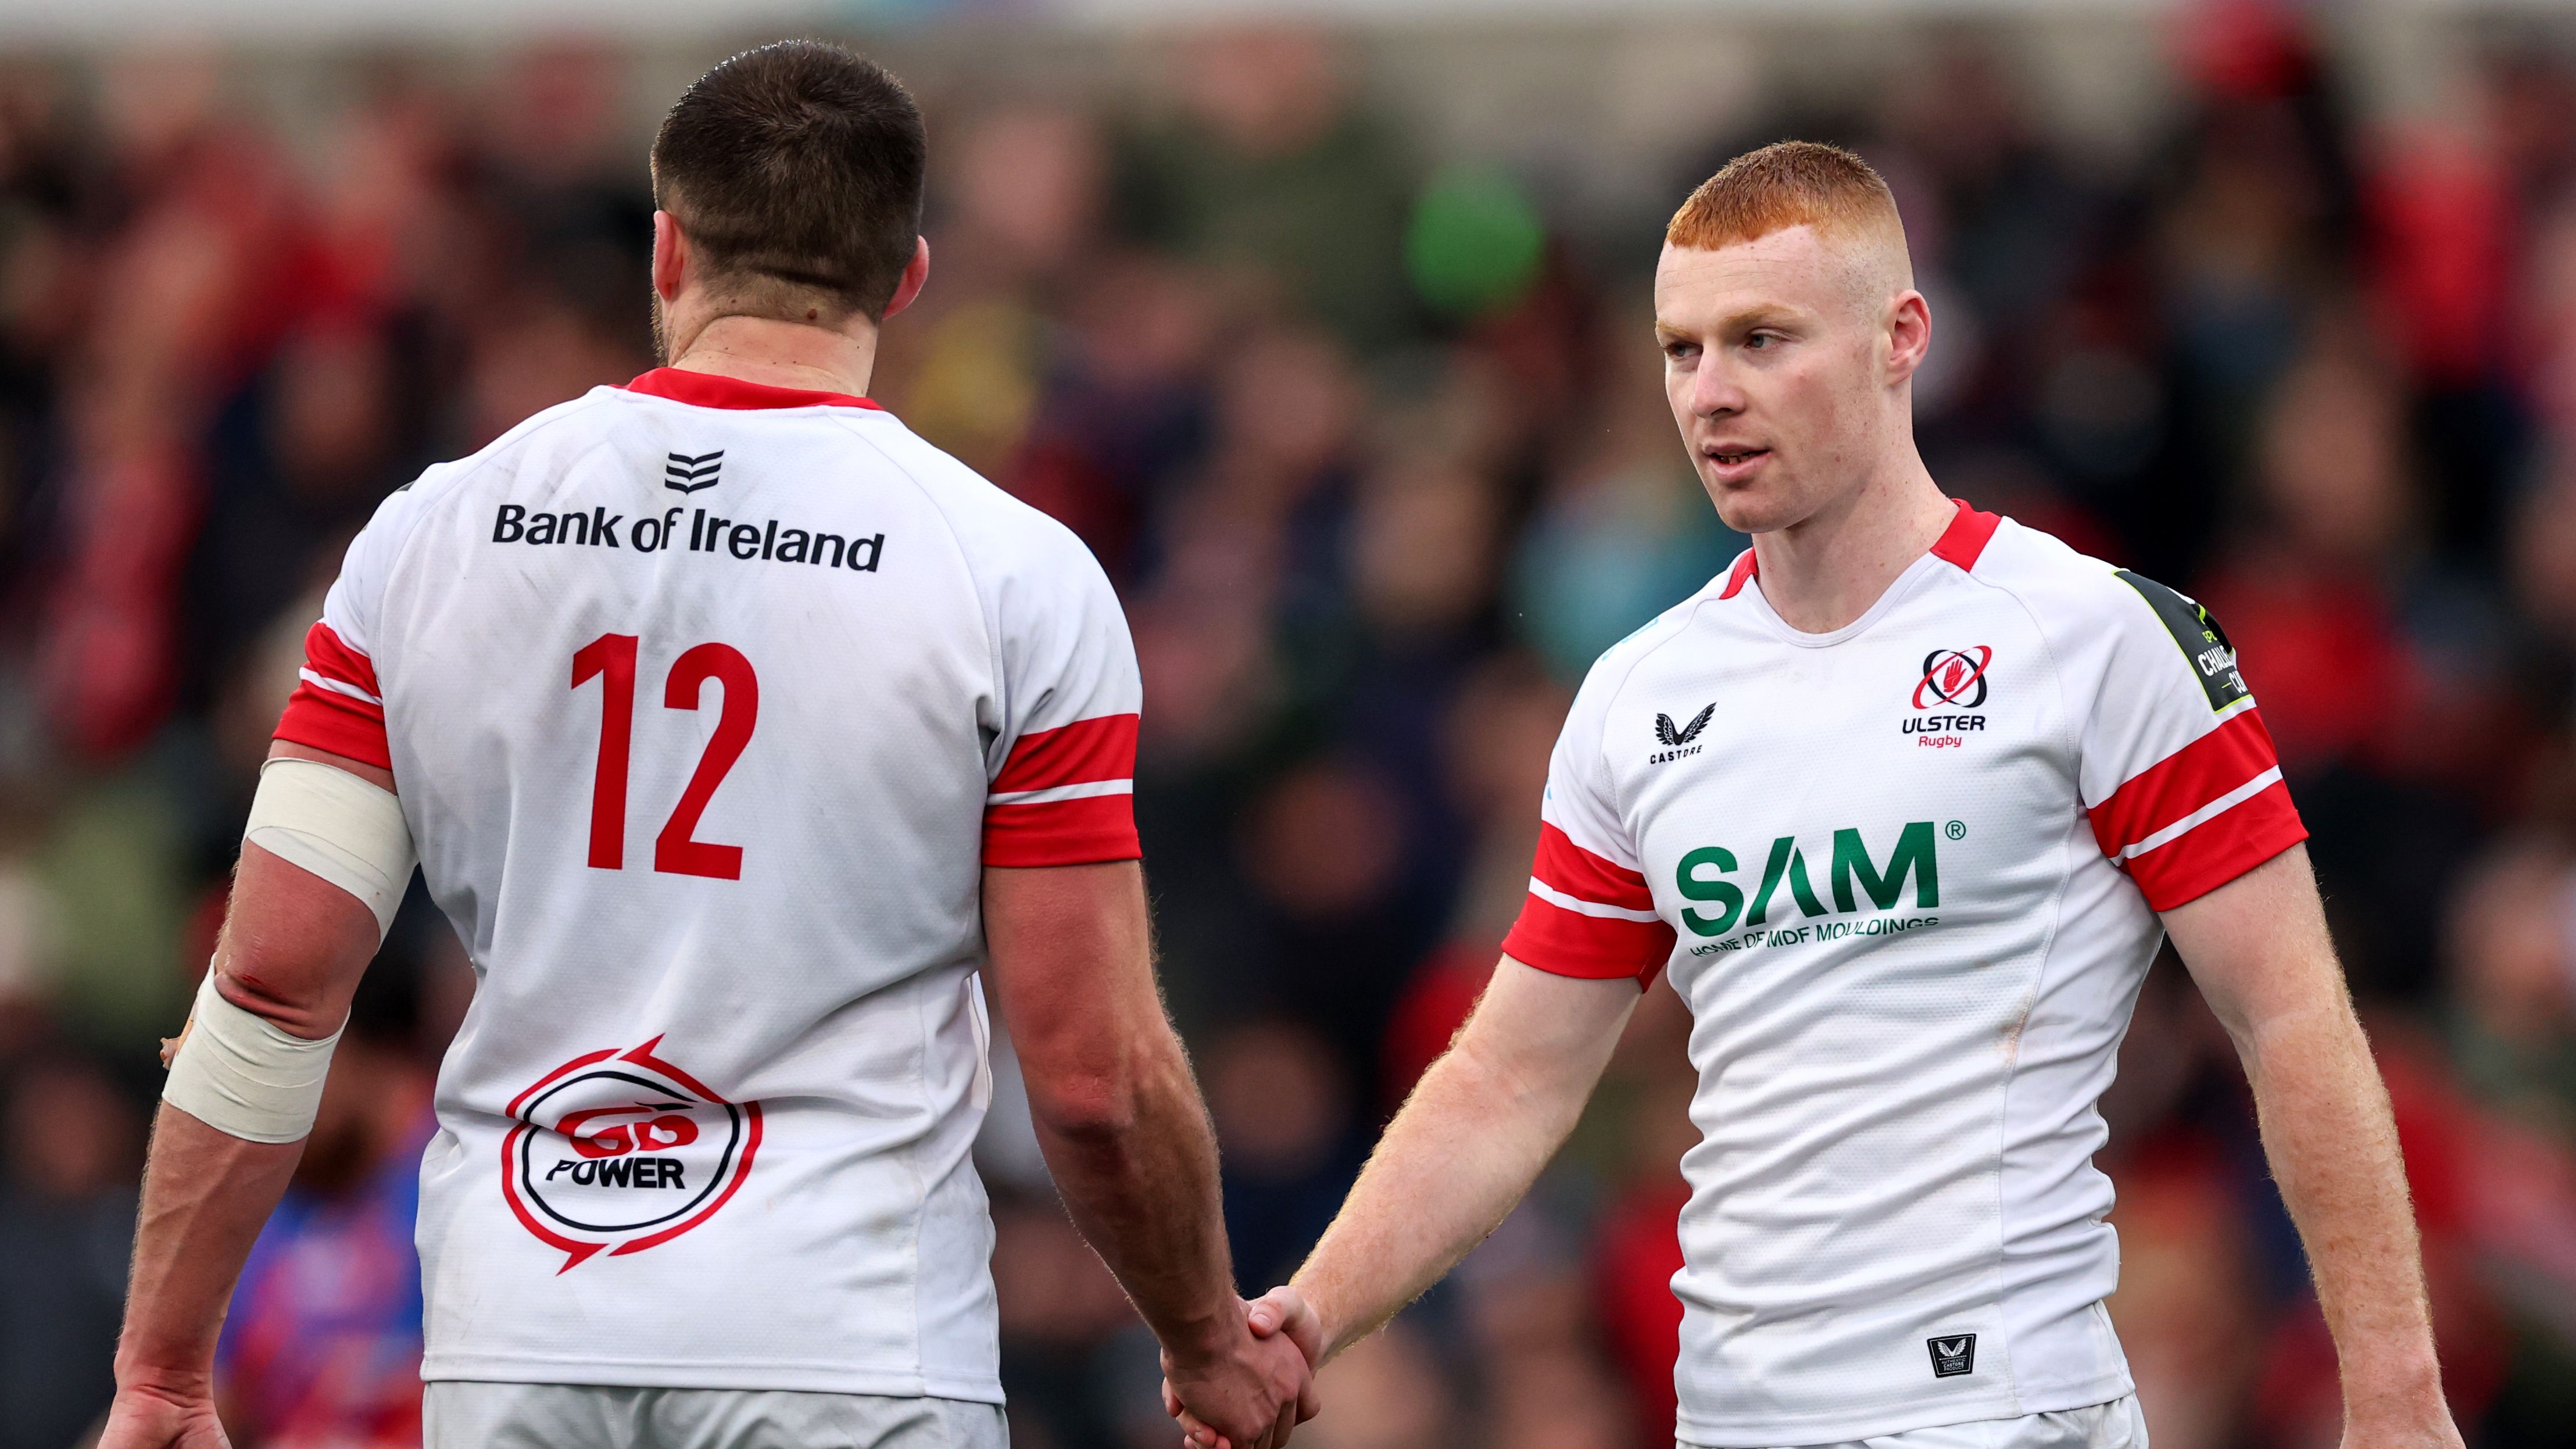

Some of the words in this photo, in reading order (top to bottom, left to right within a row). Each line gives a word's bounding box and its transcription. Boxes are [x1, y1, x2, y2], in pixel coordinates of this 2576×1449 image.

[492, 505, 624, 548] Bank
[631, 507, 683, 553] of
[690, 509, 885, 573] Ireland
[1902, 715, 1985, 734] ULSTER
[1919, 735, 1962, 748] Rugby
[571, 632, 759, 881] 12
[1650, 745, 1702, 764] CASTORE
[1676, 821, 1939, 936] SAM
[1690, 938, 1741, 957] HOME
[1767, 926, 1810, 947] MDF
[1816, 917, 1939, 942] MOULDINGS
[555, 1107, 699, 1158] GO
[545, 1157, 686, 1189] POWER
